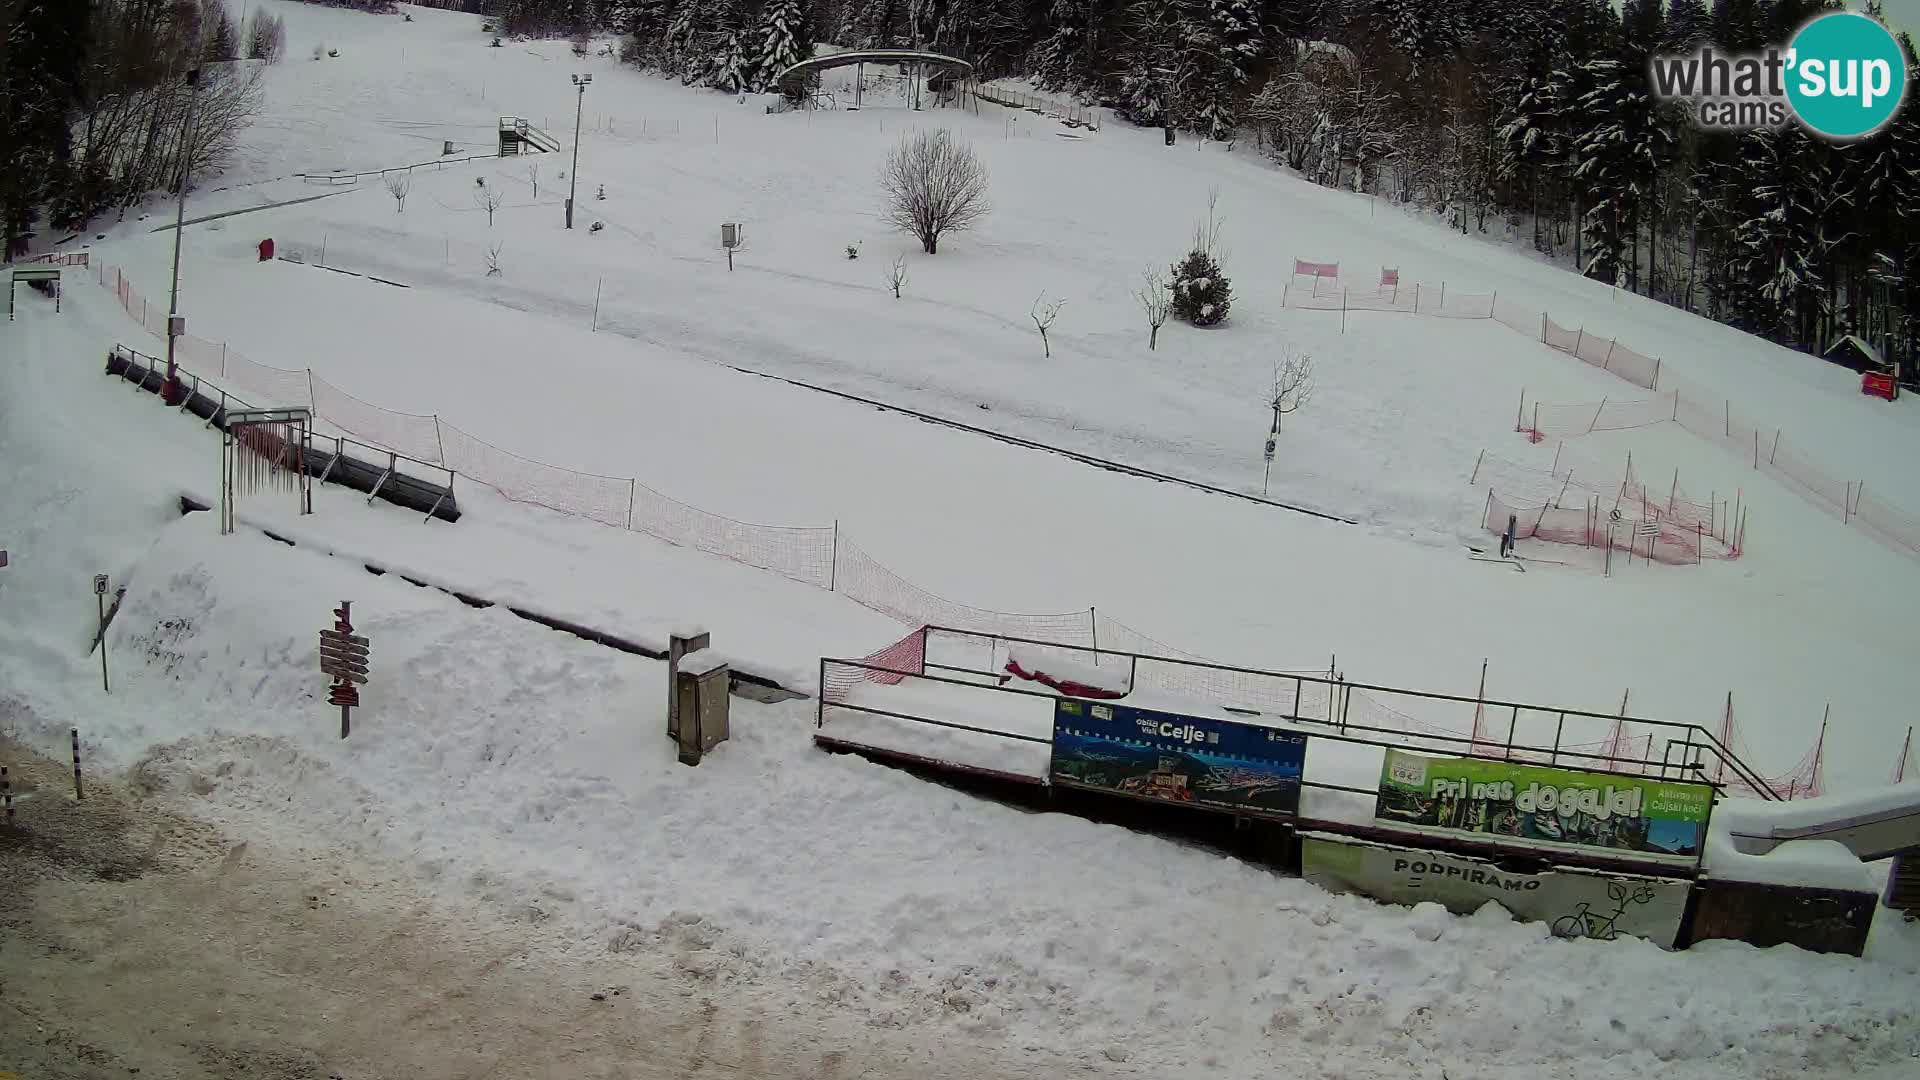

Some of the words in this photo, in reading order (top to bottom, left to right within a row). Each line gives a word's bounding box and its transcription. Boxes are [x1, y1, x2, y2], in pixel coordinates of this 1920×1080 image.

[1160, 721, 1205, 745] Celje
[1431, 777, 1468, 800] Pri
[1472, 780, 1515, 801] nas
[1394, 858, 1541, 892] PODPIRAMO
